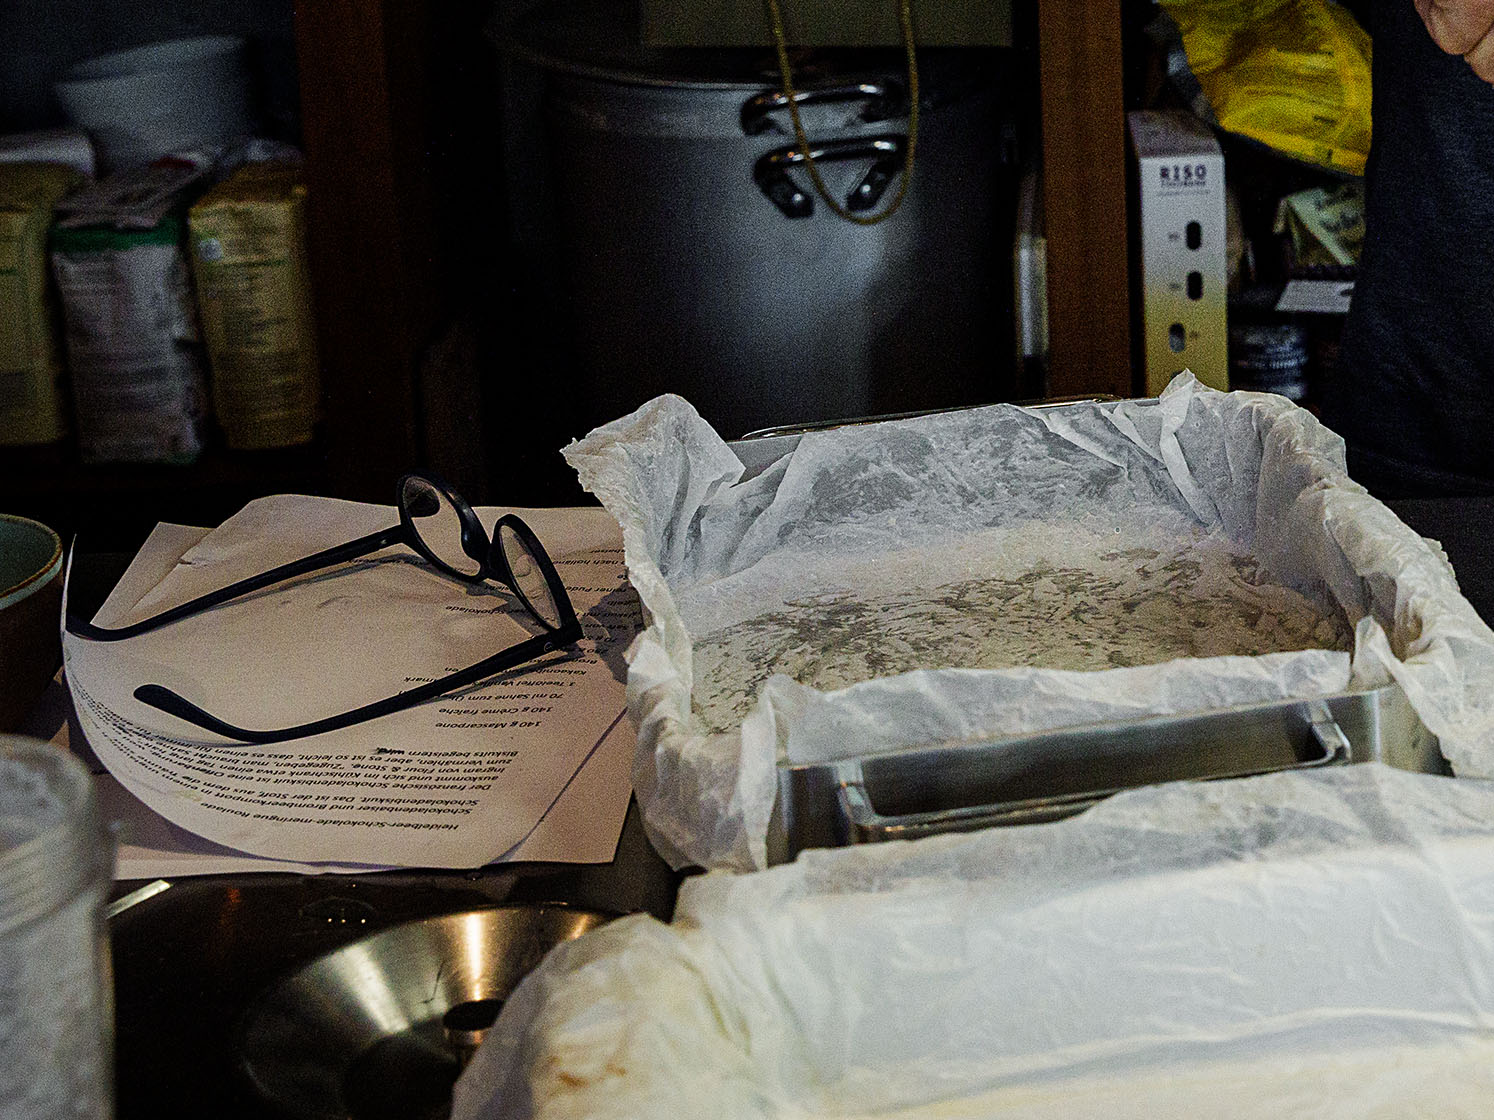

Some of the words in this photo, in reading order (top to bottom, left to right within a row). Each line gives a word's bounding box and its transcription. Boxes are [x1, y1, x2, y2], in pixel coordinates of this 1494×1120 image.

[1160, 164, 1207, 180] RISO
[214, 748, 248, 758] einen
[297, 753, 332, 761] leicht,
[407, 749, 473, 757] begeistern
[196, 759, 215, 767] Tag
[241, 758, 269, 766] man
[384, 756, 412, 764] aber
[416, 757, 482, 766] Vermählen,
[219, 764, 253, 774] einen
[350, 763, 388, 771] Stone.
[461, 765, 505, 773] Ingram
[255, 768, 285, 776] etwa
[289, 769, 361, 779] Kühlschrank
[226, 773, 253, 781] eine
[382, 773, 406, 781] sich
[434, 774, 498, 782] auskommt
[203, 781, 230, 791] dem
[272, 777, 389, 789] Schokoladenbiskuit
[392, 782, 466, 791] französische
[258, 790, 289, 799] Stoff,
[214, 792, 326, 809] Brombeerkompott
[360, 796, 479, 805] Schokoladenbiskuit.
[200, 802, 249, 818] Roulade
[329, 804, 354, 812] und
[357, 804, 472, 814] Schokoladenbaiser
